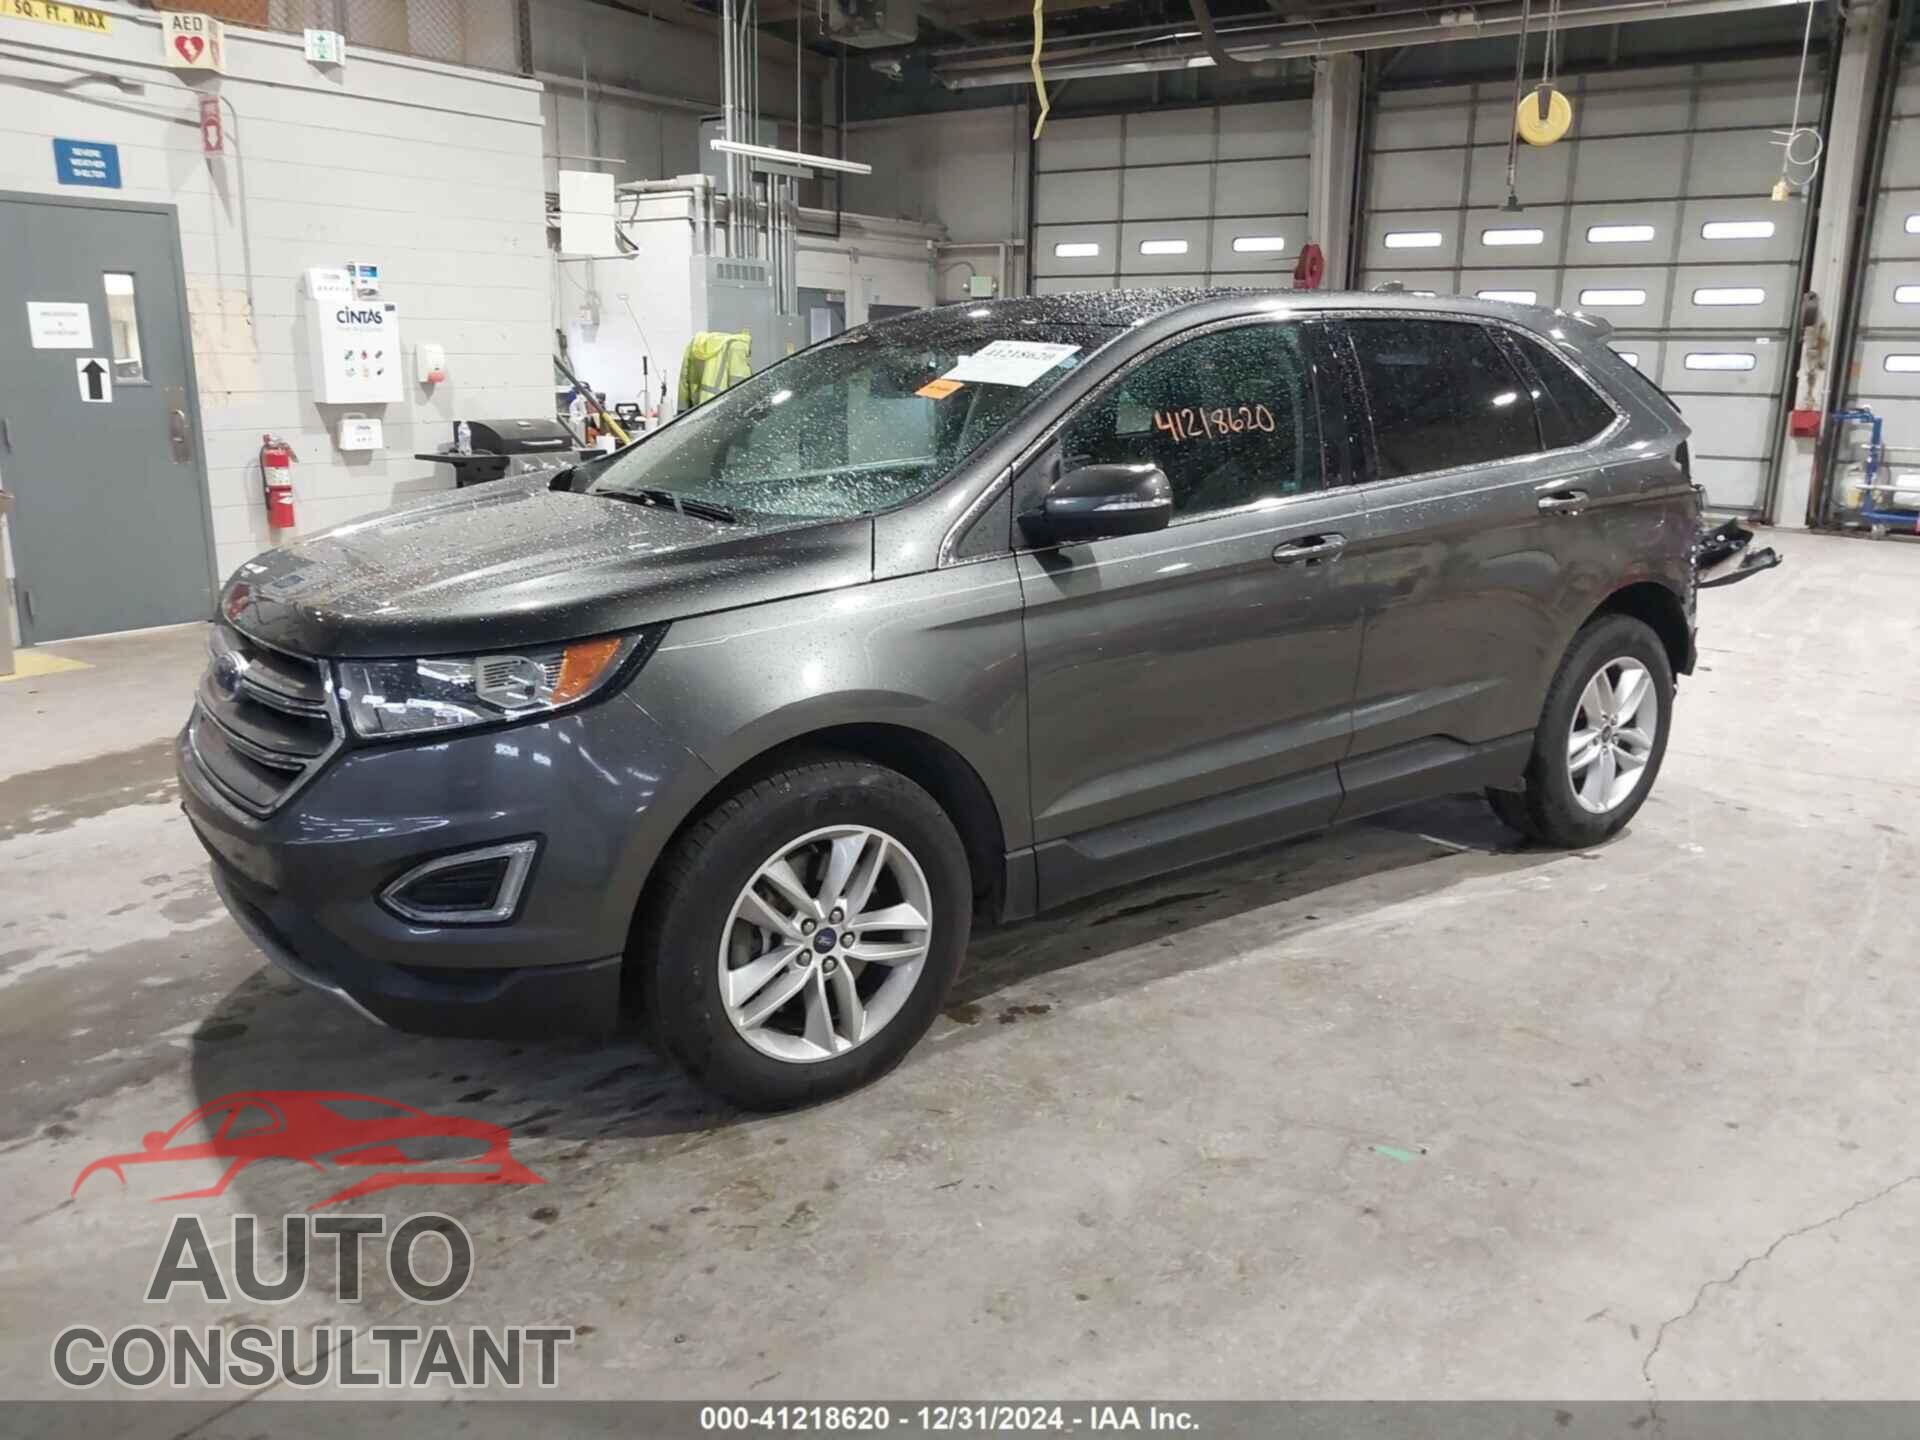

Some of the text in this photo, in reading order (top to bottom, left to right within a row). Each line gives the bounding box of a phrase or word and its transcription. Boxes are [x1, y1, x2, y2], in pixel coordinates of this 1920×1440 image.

[14, 0, 105, 30] SQ. FT. MAX
[172, 15, 203, 32] AED
[336, 305, 383, 325] CINTAS
[1154, 404, 1275, 442] 41218620
